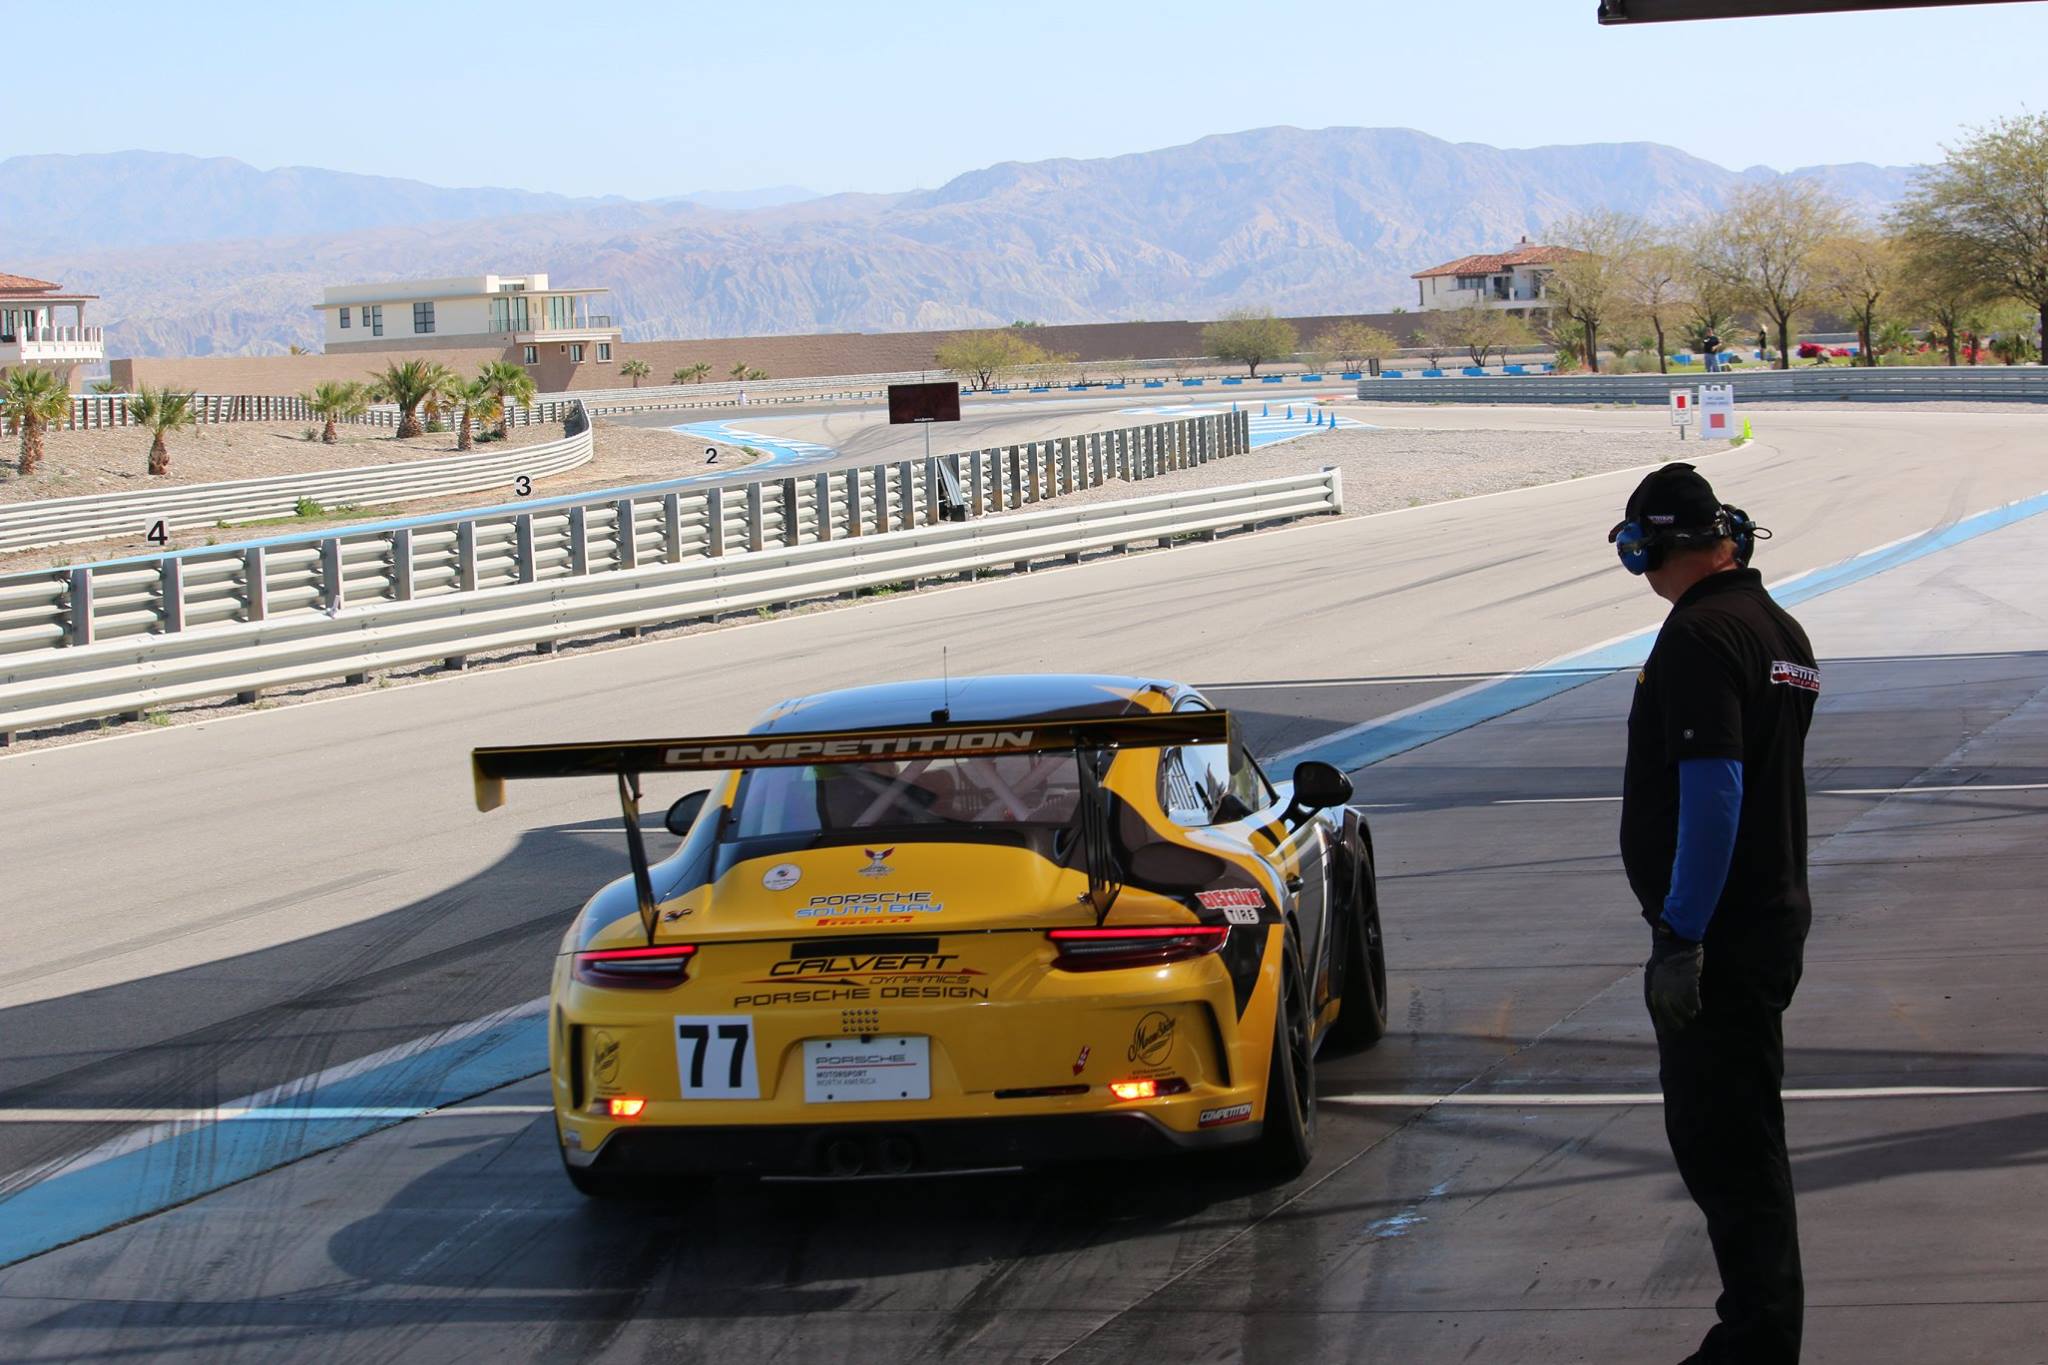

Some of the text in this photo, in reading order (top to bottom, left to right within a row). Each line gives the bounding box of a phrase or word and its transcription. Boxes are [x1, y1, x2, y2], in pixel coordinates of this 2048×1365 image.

[705, 447, 719, 464] 2
[515, 475, 532, 497] 3
[147, 520, 169, 546] 4
[664, 731, 1034, 764] COMPETITION
[809, 892, 932, 907] PORSCHE
[795, 903, 943, 918] SOUTH BAY
[1226, 908, 1257, 921] TIRE
[769, 955, 960, 976] CALVERT
[868, 975, 972, 985] DYNAMICS
[733, 986, 990, 1008] PORSCHE DESIGN
[679, 1024, 749, 1088] 77
[815, 1054, 906, 1065] PORSCHE
[816, 1069, 868, 1079] MOTORSPORT
